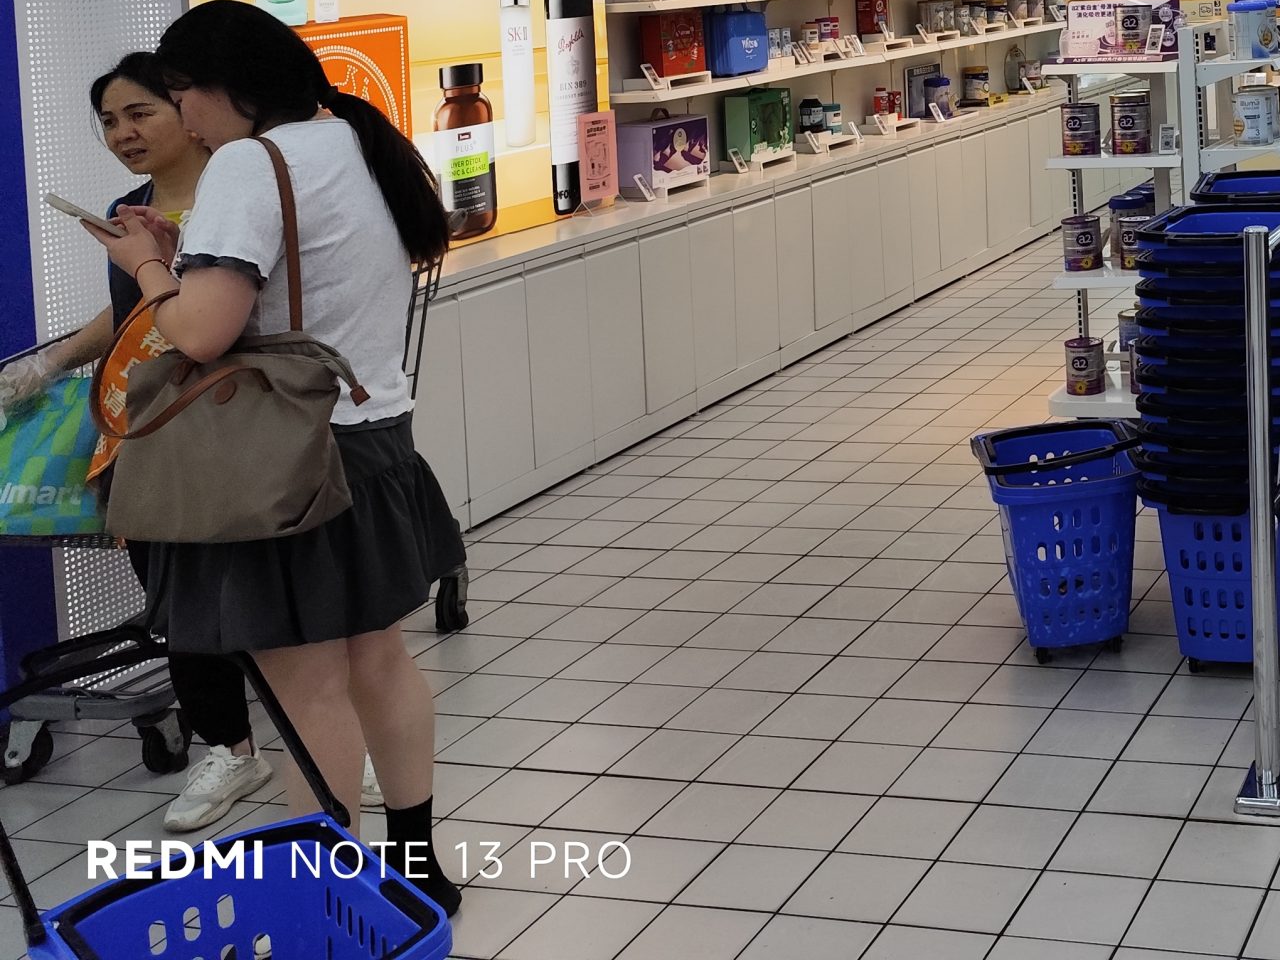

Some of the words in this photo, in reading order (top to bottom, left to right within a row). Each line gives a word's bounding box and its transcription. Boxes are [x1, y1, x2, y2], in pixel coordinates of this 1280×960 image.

[1123, 17, 1137, 30] a2
[574, 79, 588, 89] 389
[1067, 119, 1081, 129] a2
[1119, 117, 1133, 127] a2
[1078, 234, 1092, 244] a2
[1123, 233, 1134, 243] a2
[1073, 358, 1088, 369] a2
[0, 482, 82, 506] lmart
